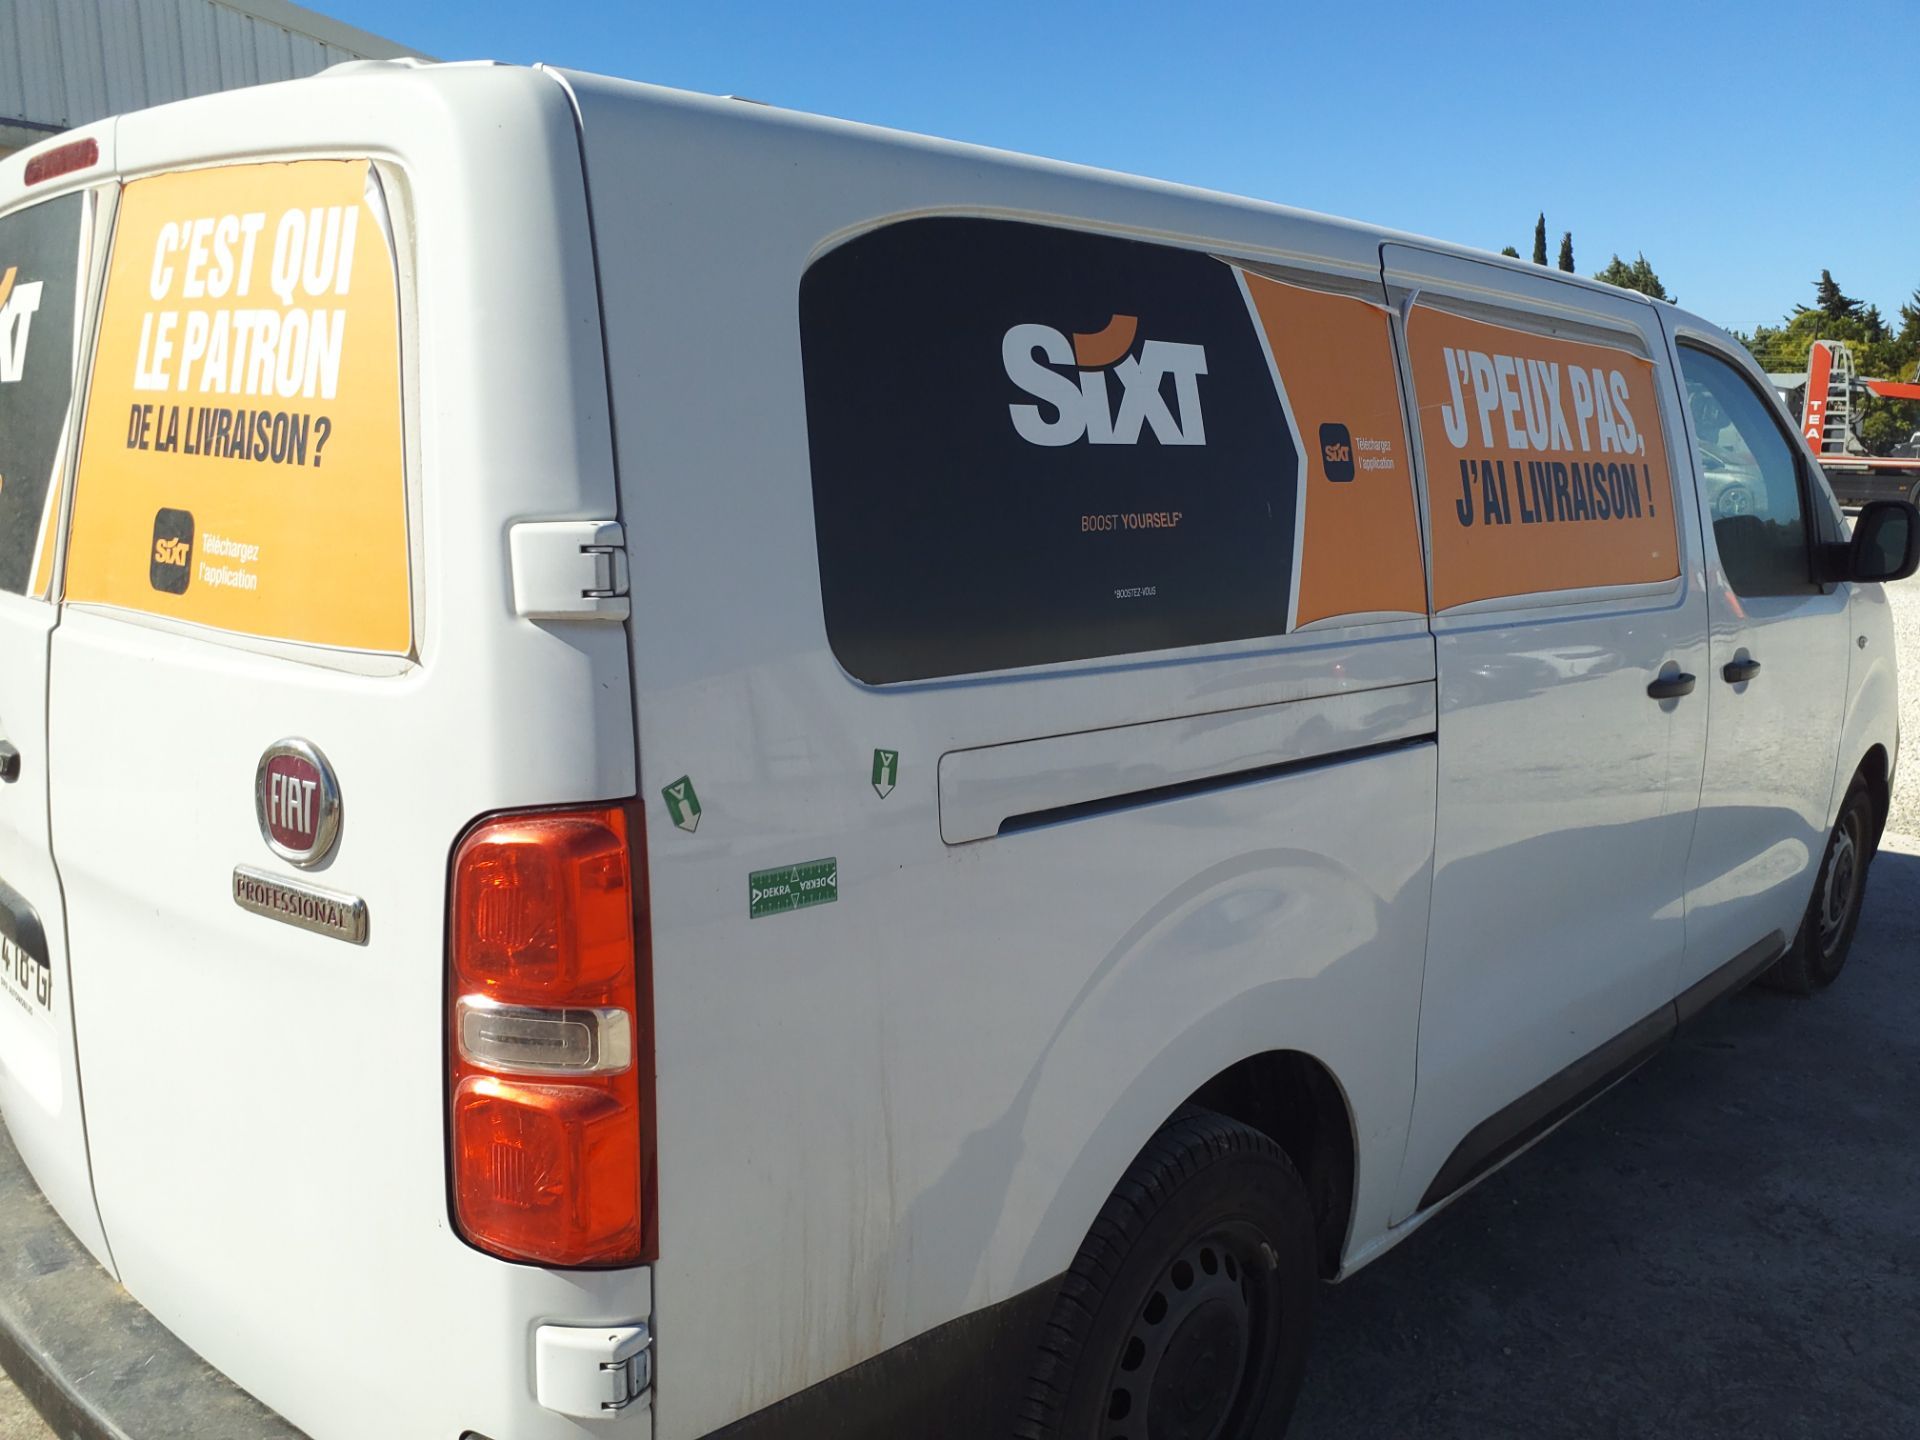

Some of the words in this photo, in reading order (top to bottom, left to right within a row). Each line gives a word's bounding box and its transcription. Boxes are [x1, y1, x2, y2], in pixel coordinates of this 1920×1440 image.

[150, 212, 266, 301] C'EST
[271, 205, 359, 306] QUI
[133, 311, 179, 391] LE
[178, 308, 347, 400] PATRON
[1441, 347, 1573, 452] J'PEUX
[1568, 364, 1645, 457] PAS,
[127, 404, 153, 450] DE
[154, 405, 179, 453] LA
[183, 407, 310, 465] LIVRAISON
[1456, 459, 1512, 527] J'AI
[1513, 461, 1642, 524] LIVRAISON
[202, 533, 260, 564] Téléchargez
[1081, 514, 1119, 532] BOOST
[198, 561, 258, 591] l'application
[271, 772, 317, 834] FIAT
[237, 878, 347, 930] PROFESSIONAL
[763, 884, 791, 899] DEKRA
[800, 877, 826, 891] DEKRA
